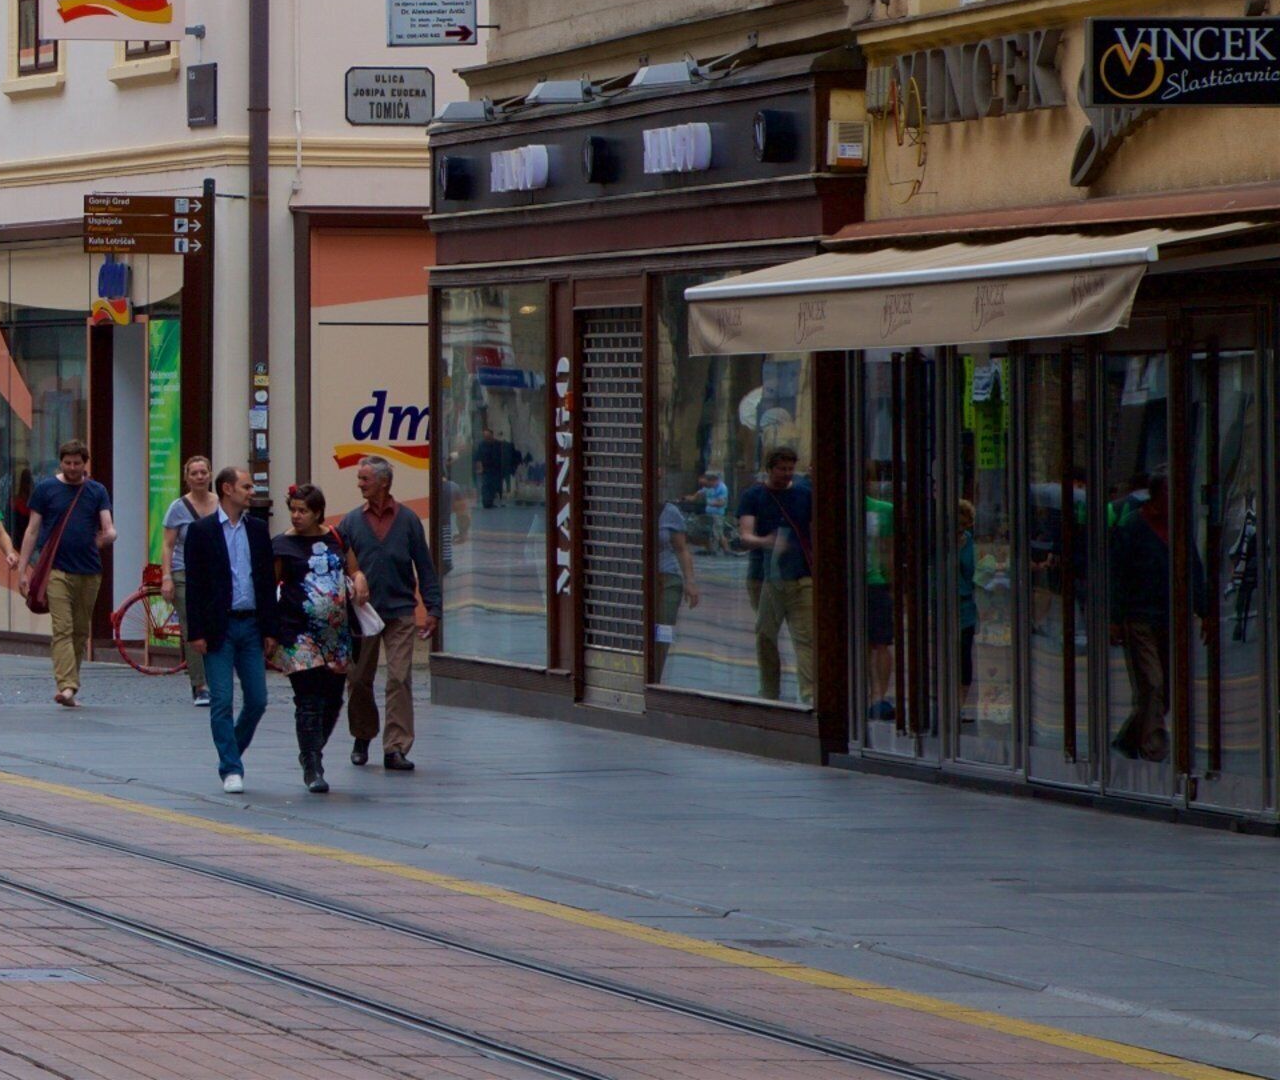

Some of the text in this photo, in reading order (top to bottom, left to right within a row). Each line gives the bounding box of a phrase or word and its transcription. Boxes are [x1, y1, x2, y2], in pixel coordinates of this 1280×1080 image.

[1114, 26, 1277, 62] VINCEK
[374, 74, 405, 84] ULICA
[896, 29, 1067, 129] VINCEK
[353, 88, 386, 98] JOSIPA
[369, 98, 411, 120] TOMIĆA
